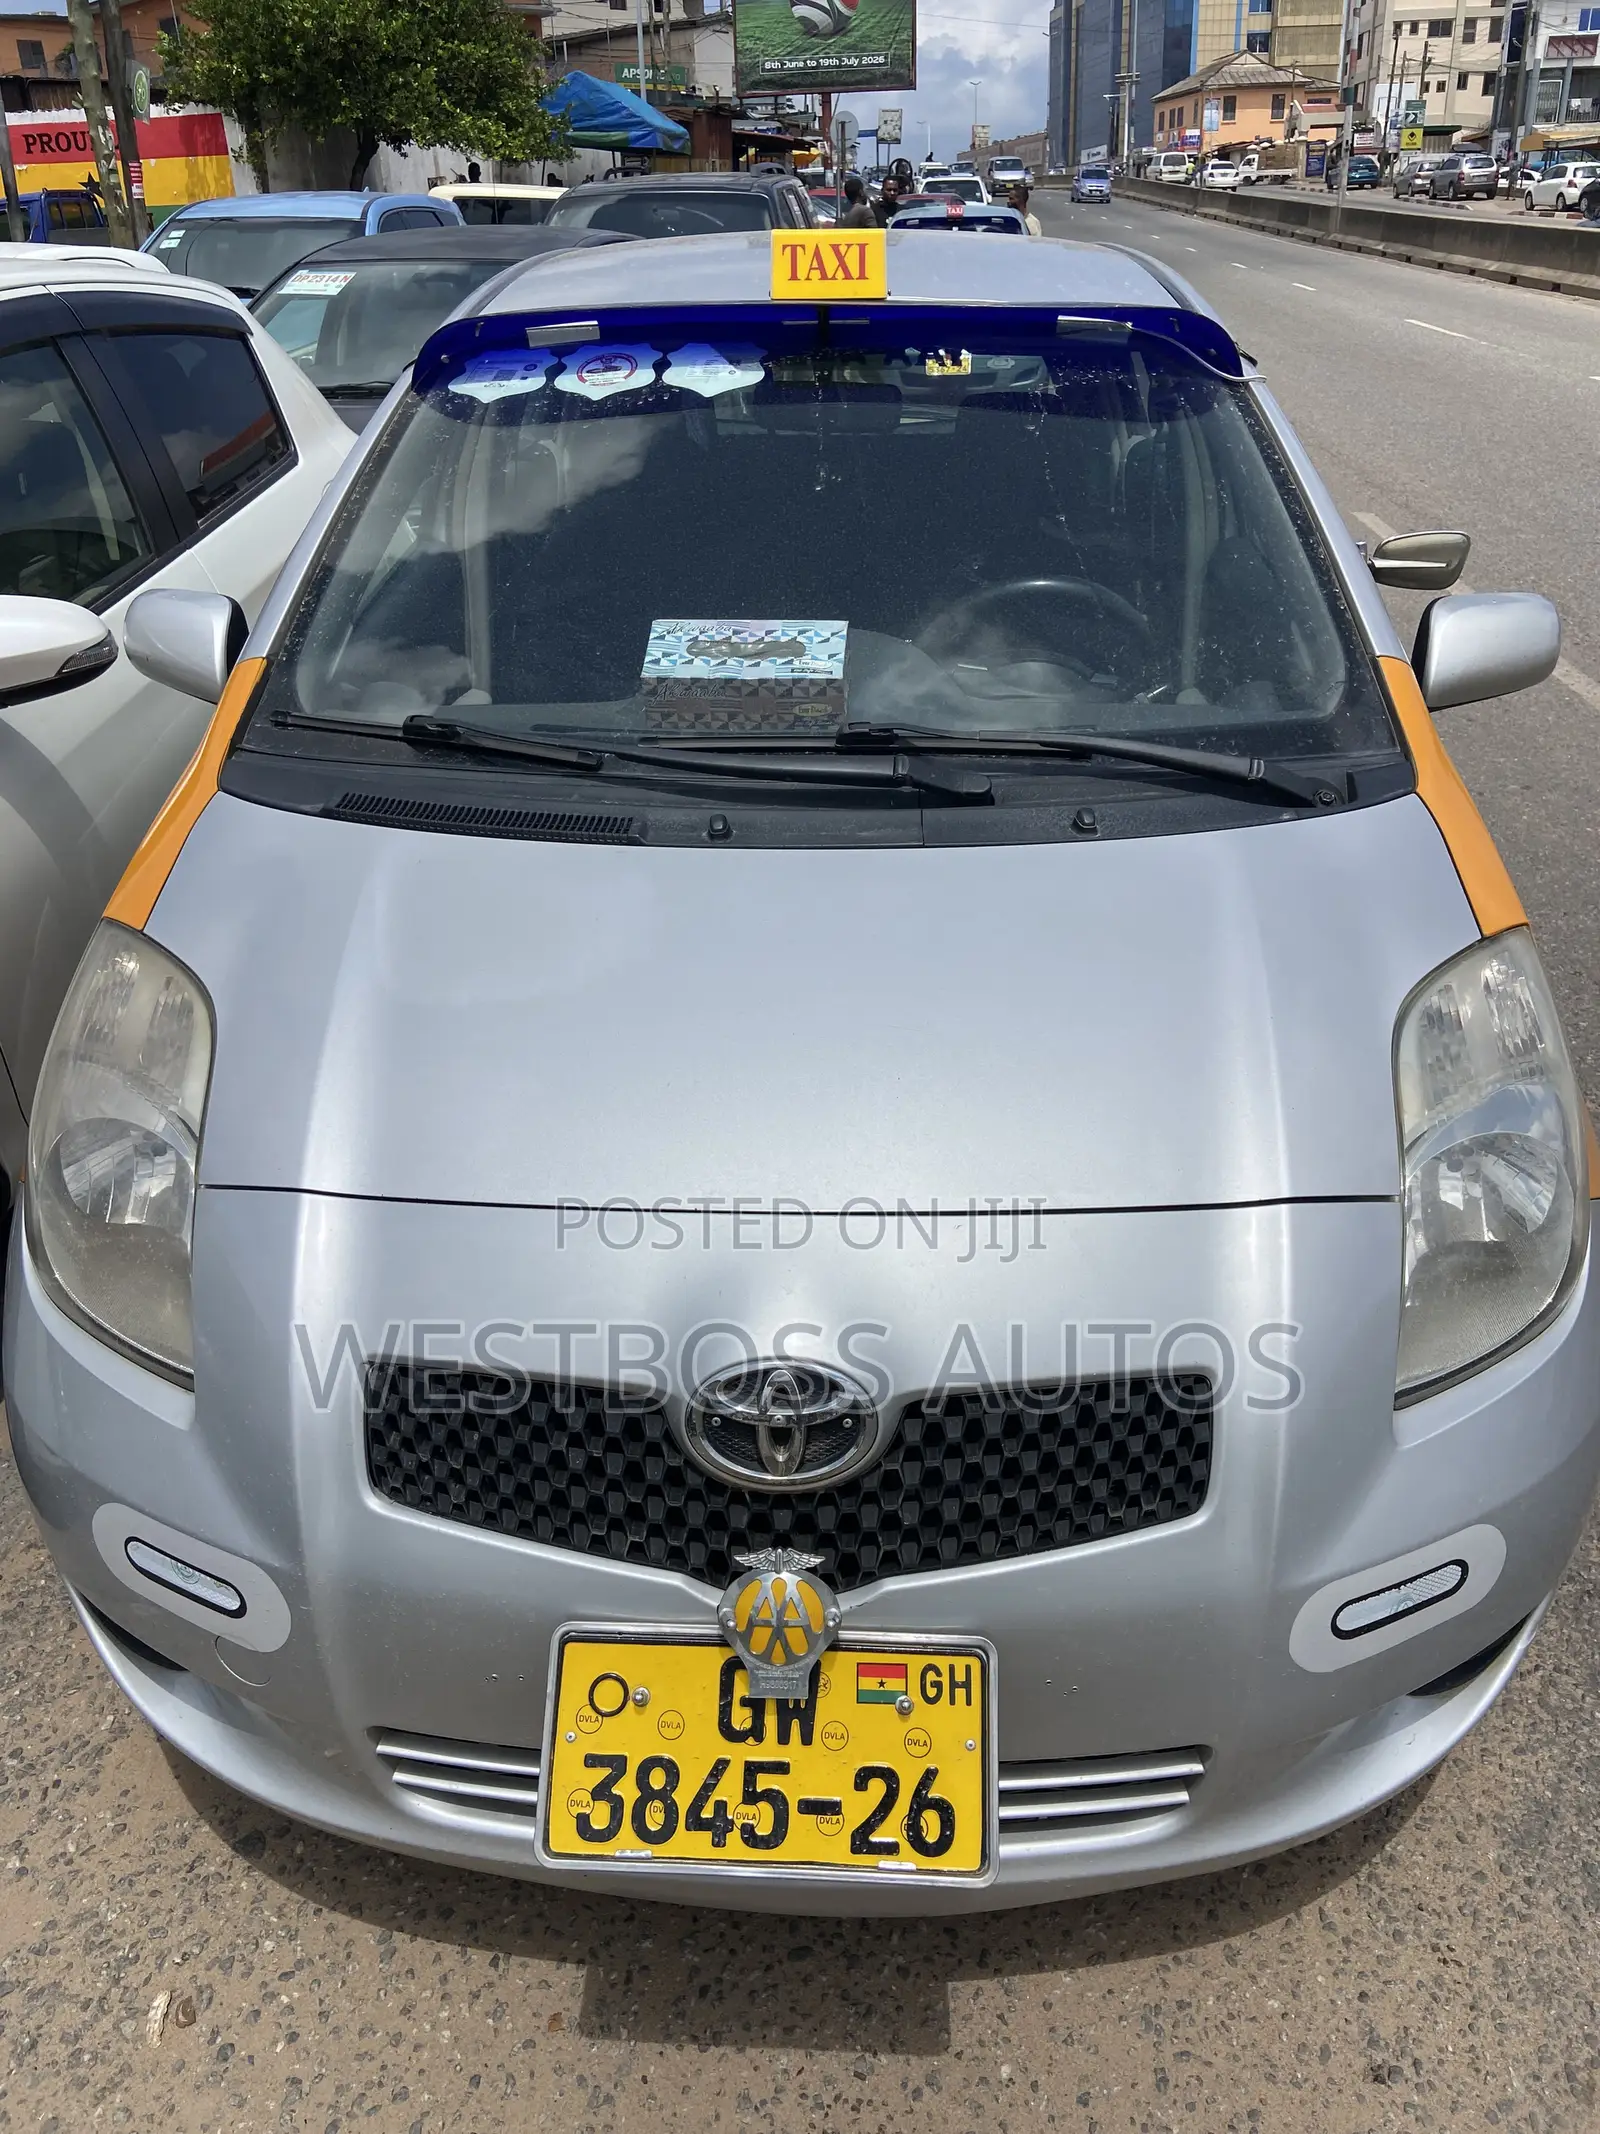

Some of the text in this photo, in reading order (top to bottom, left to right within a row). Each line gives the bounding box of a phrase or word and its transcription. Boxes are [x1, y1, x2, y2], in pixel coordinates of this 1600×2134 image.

[764, 55, 885, 69] 8th June to 19th July 2026
[23, 130, 97, 155] PROU
[781, 243, 870, 281] TAXI
[920, 1663, 972, 1706] GH
[717, 1656, 821, 1746] GW
[578, 1714, 600, 1724] DVLA
[660, 1720, 681, 1729] DVLA
[824, 1731, 845, 1741] DVLA
[907, 1738, 928, 1747] DVLA
[569, 1799, 591, 1808] DVLA
[576, 1752, 955, 1858] 3845-26
[735, 1811, 757, 1821] DVLA
[819, 1816, 840, 1825] DVLA
